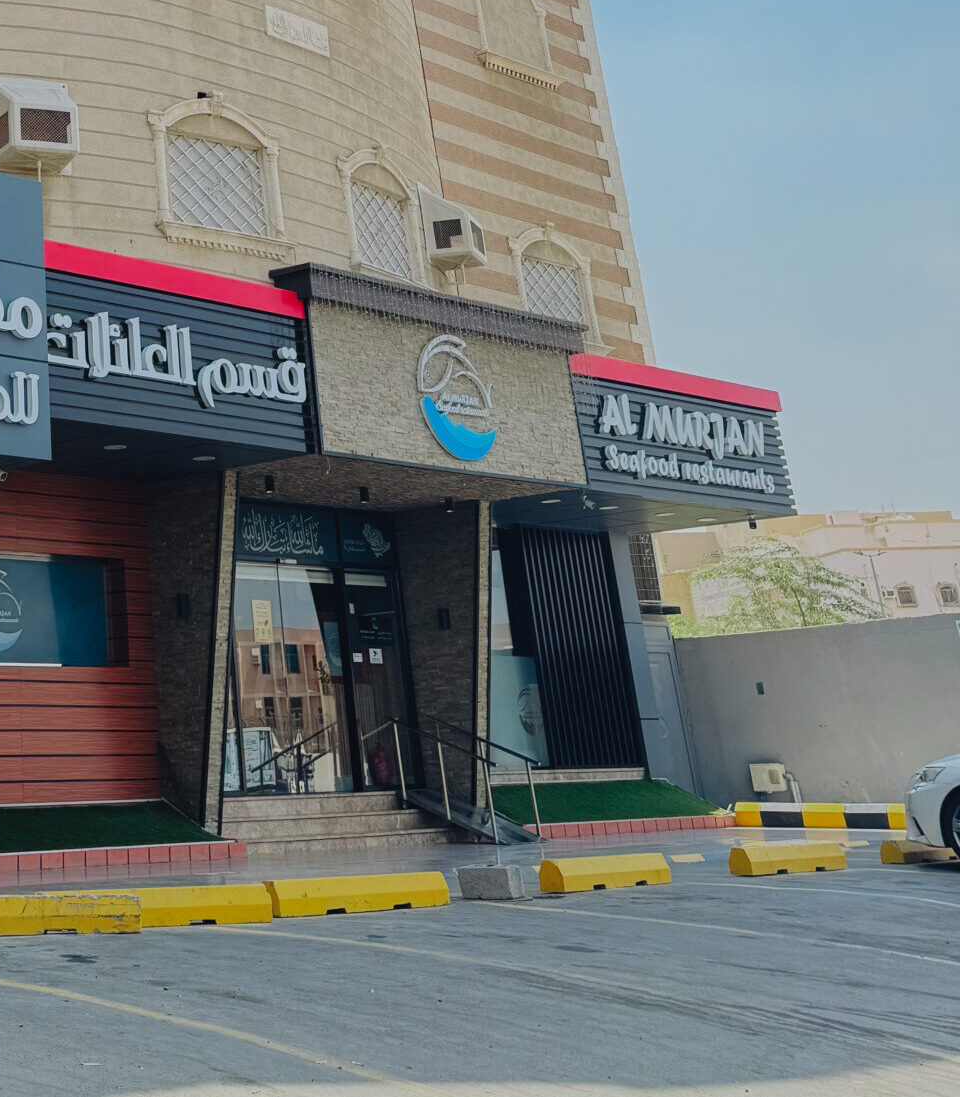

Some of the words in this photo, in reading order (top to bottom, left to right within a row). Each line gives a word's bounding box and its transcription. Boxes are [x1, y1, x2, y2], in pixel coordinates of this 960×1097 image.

[198, 346, 307, 408] قسم
[599, 394, 638, 436] AL
[642, 402, 765, 460] MURJAN
[605, 445, 681, 480] Seafood
[681, 460, 776, 494] restaurants
